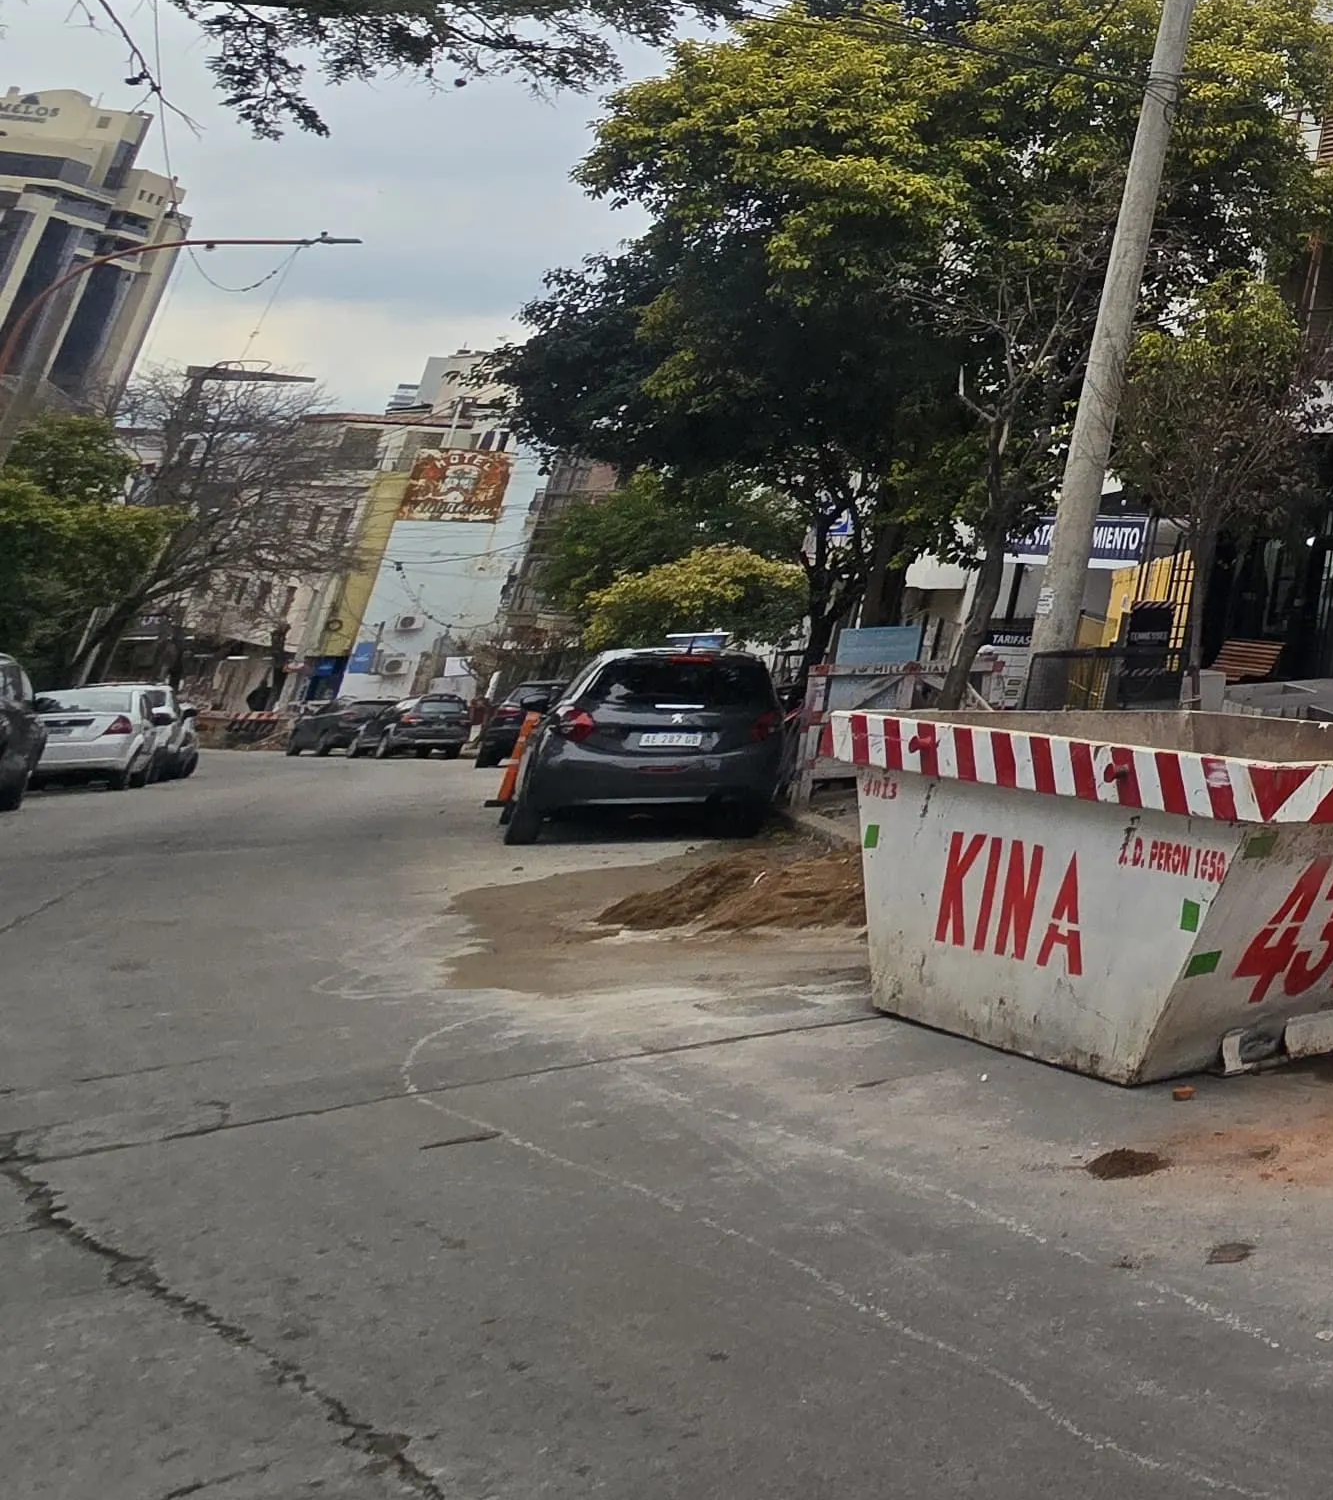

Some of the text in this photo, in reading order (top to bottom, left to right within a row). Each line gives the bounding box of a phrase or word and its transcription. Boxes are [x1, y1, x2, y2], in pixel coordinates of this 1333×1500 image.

[434, 453, 492, 471] HOTEL
[992, 634, 1032, 645] TARIFAS
[1148, 839, 1192, 877] PERON
[1194, 847, 1226, 885] 1650
[935, 831, 1084, 977] KINA
